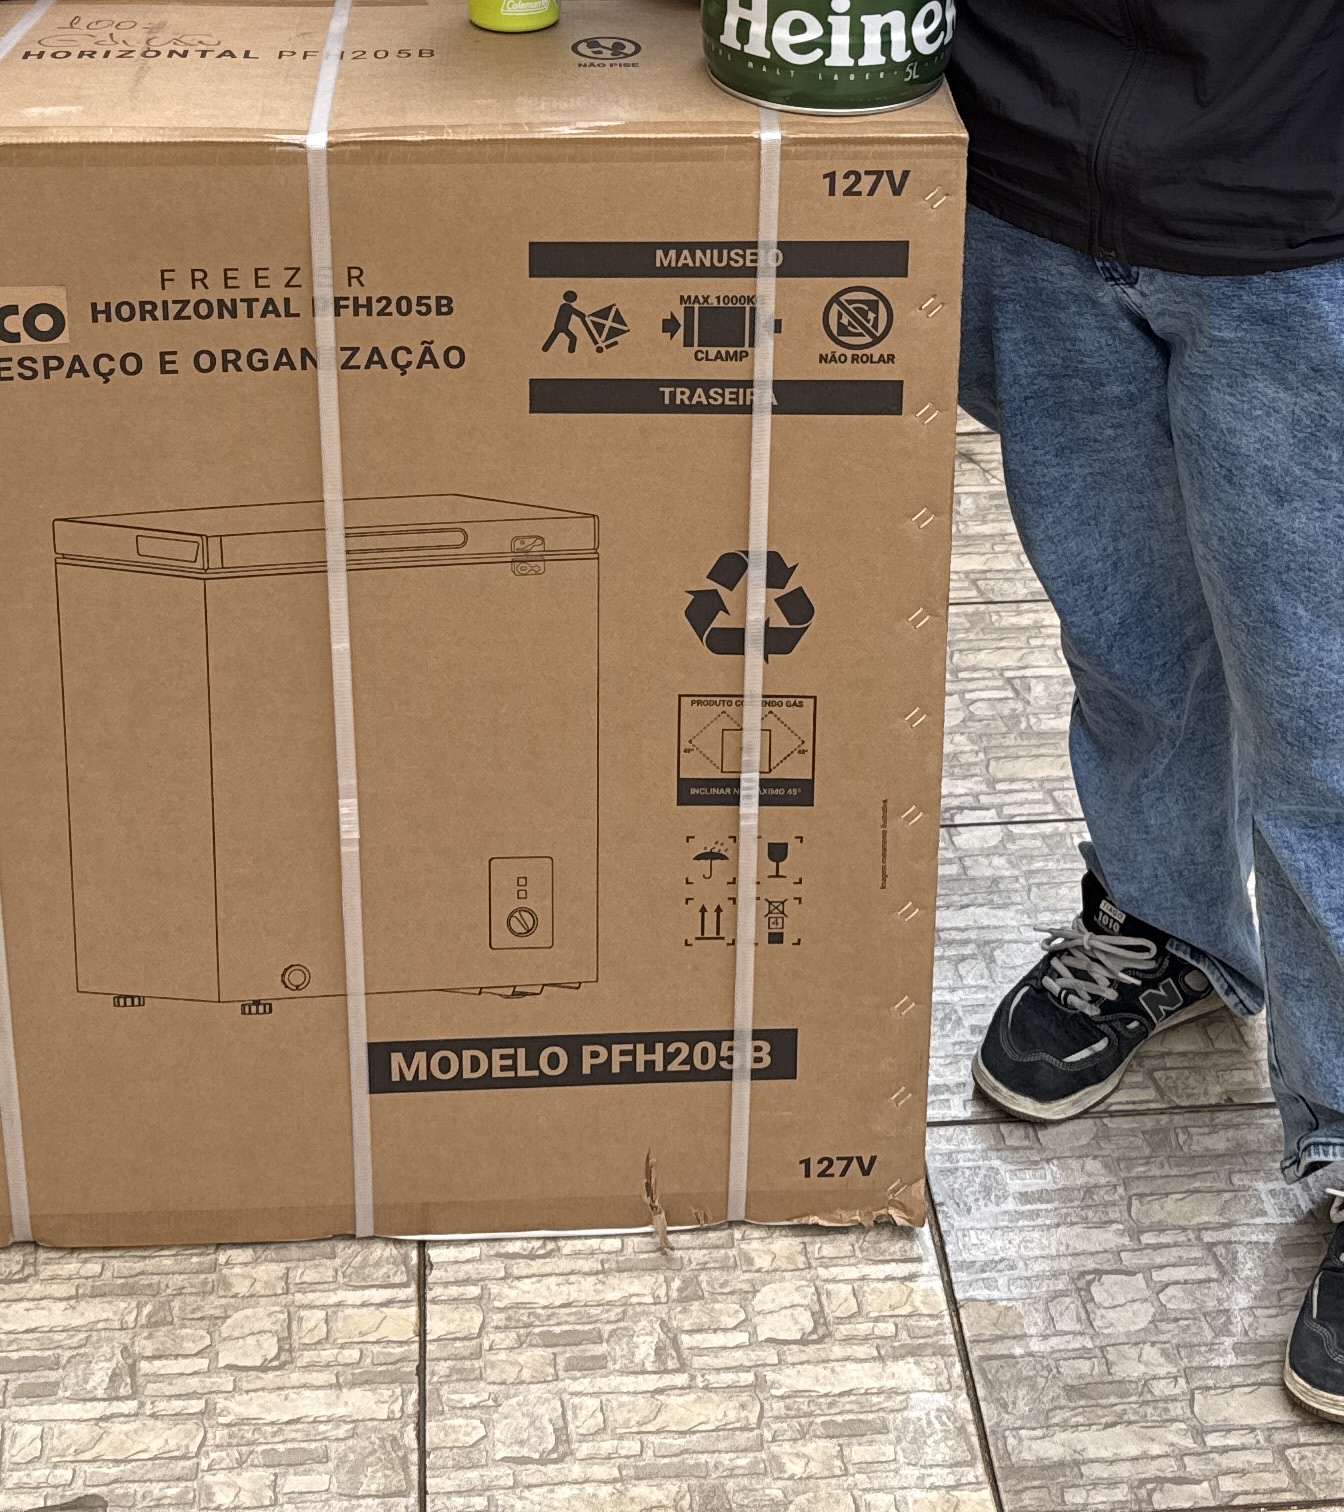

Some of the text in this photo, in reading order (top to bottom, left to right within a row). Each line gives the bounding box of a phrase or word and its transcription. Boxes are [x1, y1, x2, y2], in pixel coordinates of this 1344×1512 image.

[21, 49, 259, 60] HORIZONTAL
[904, 61, 920, 82] 5L
[822, 170, 911, 197] 127V
[160, 266, 365, 290] FREEZR
[91, 295, 454, 323] HORIZONTAL FH205B
[159, 350, 179, 375] E
[193, 340, 466, 376] ORGANZAÇÃO
[694, 350, 749, 362] CLAMP
[818, 351, 896, 364] NÃO ROLAR
[690, 699, 733, 707] PRODUTO
[785, 698, 804, 708] GÁS
[690, 787, 731, 795] INCLINAR
[390, 1039, 772, 1083] MODELO PFH205B
[799, 1155, 877, 1178] 127V
